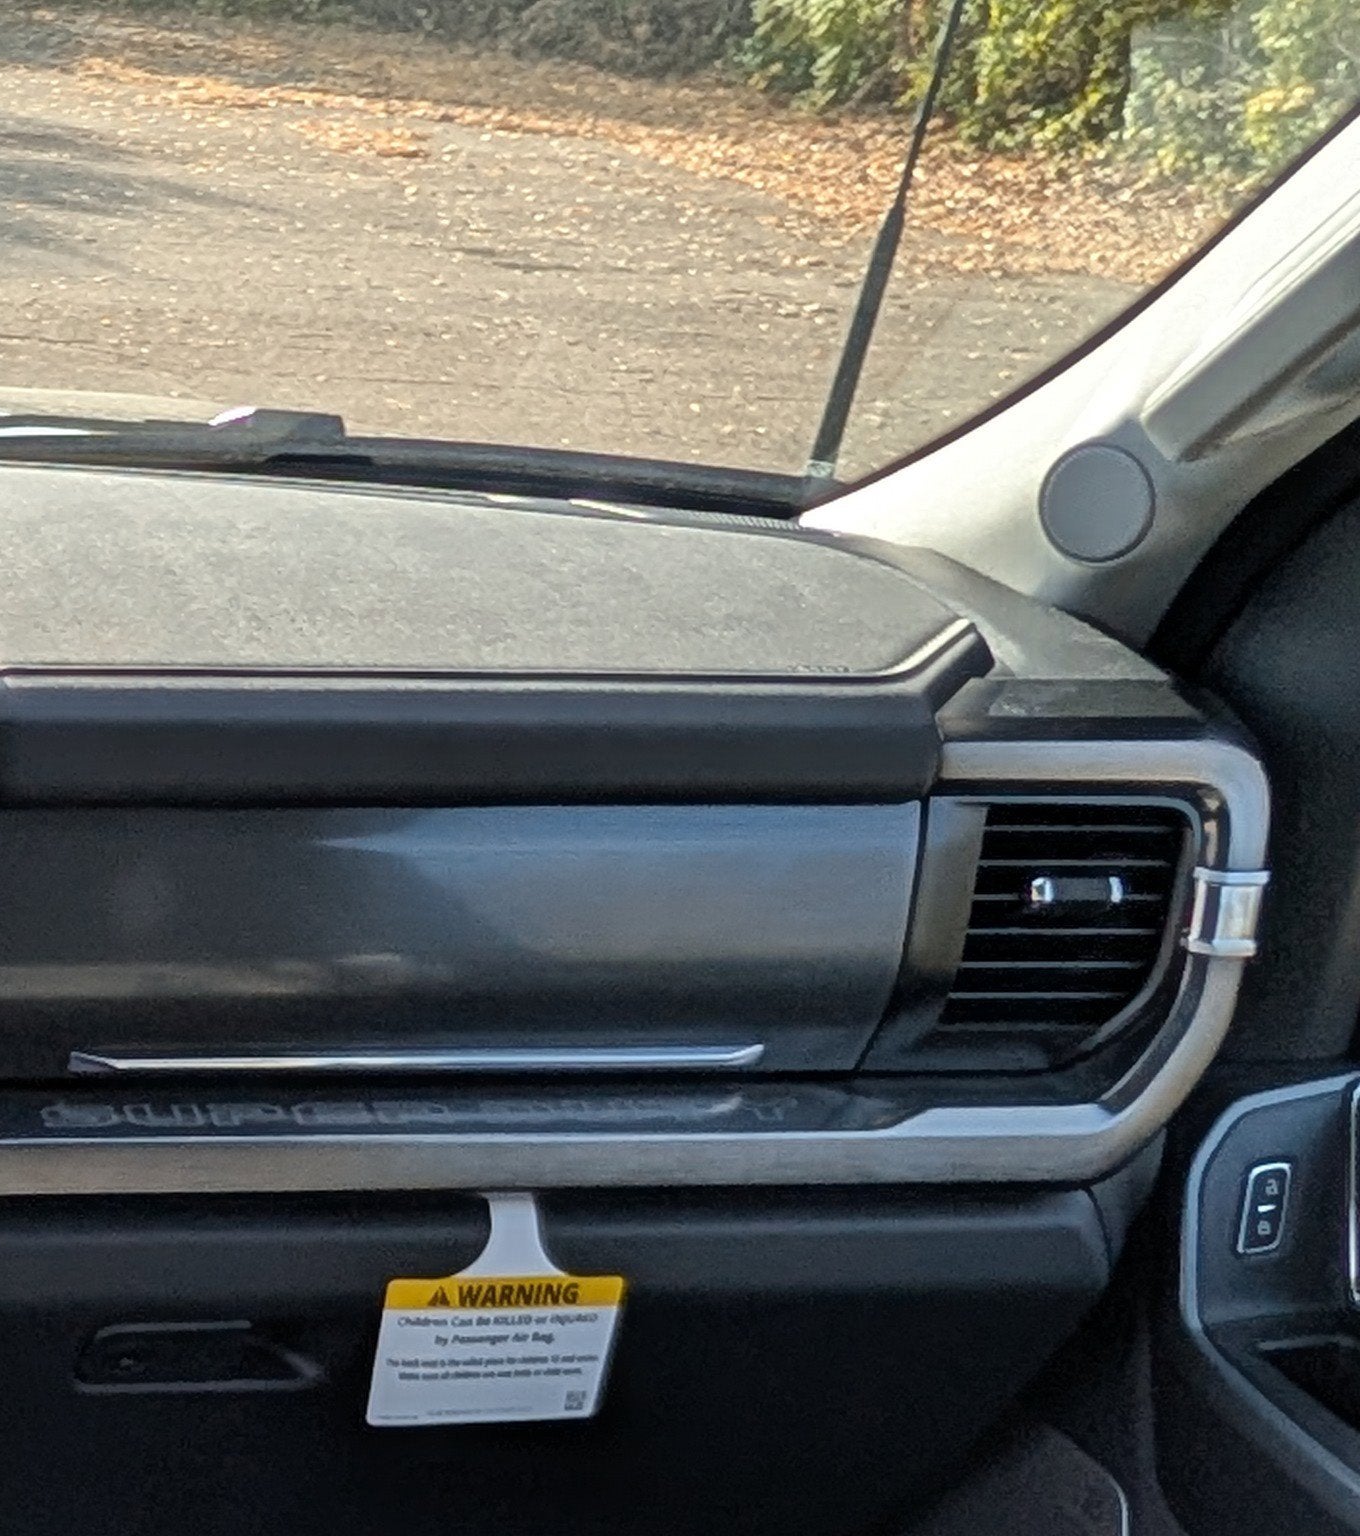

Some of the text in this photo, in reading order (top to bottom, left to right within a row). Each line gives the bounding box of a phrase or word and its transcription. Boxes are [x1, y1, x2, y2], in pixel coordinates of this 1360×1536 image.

[457, 1283, 580, 1307] WARNING
[397, 1315, 448, 1328] Children
[451, 1315, 473, 1328] Can
[493, 1314, 533, 1326] KILLED
[434, 1334, 448, 1347] by
[451, 1333, 510, 1346] Passenger
[512, 1332, 530, 1343] Air
